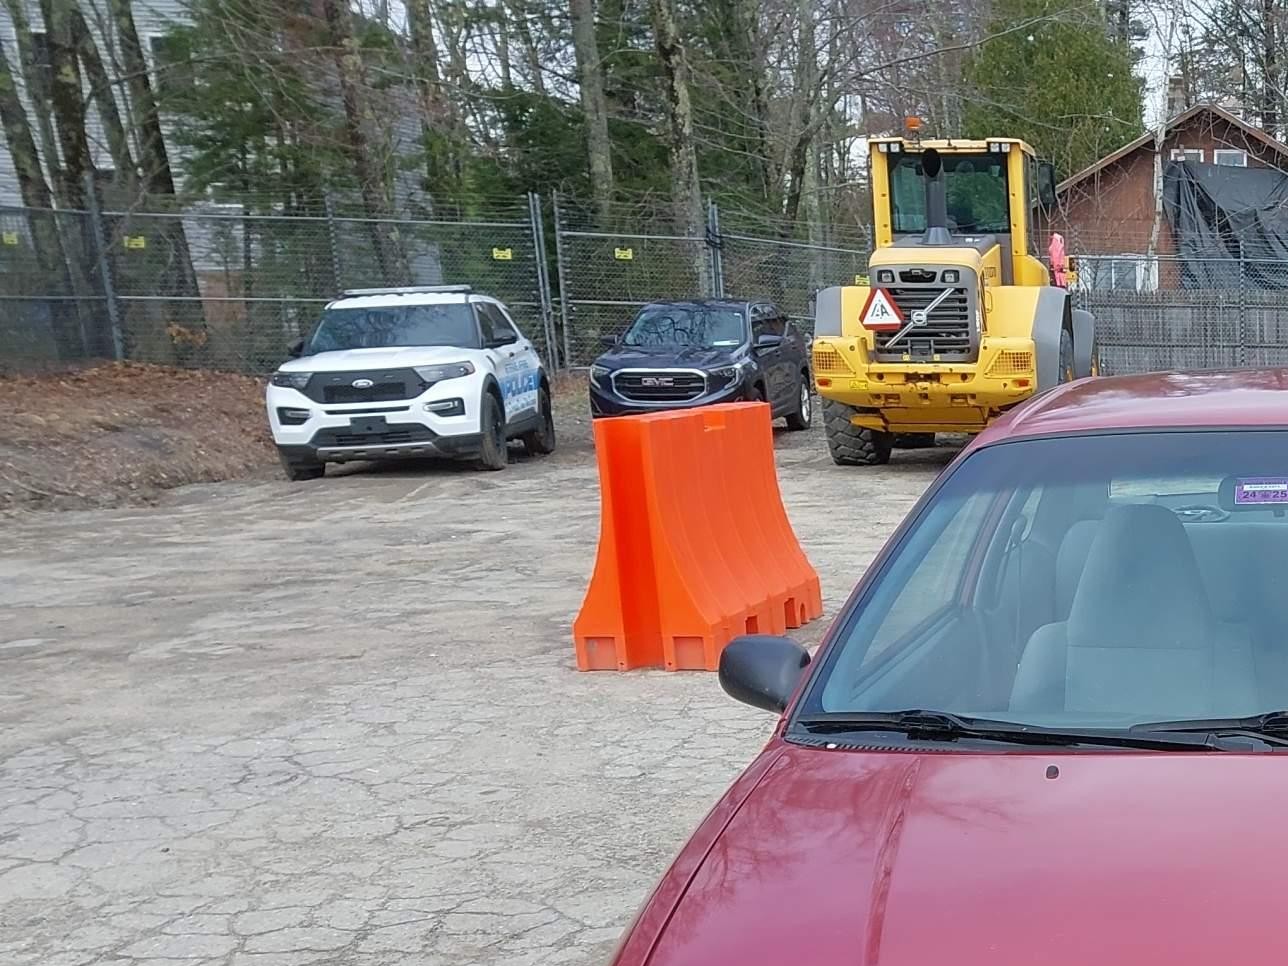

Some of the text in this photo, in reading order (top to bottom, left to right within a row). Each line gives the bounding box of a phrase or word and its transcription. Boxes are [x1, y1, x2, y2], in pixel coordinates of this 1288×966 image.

[641, 377, 674, 386] GMC
[1242, 491, 1257, 499] 24
[1272, 490, 1288, 499] 25
